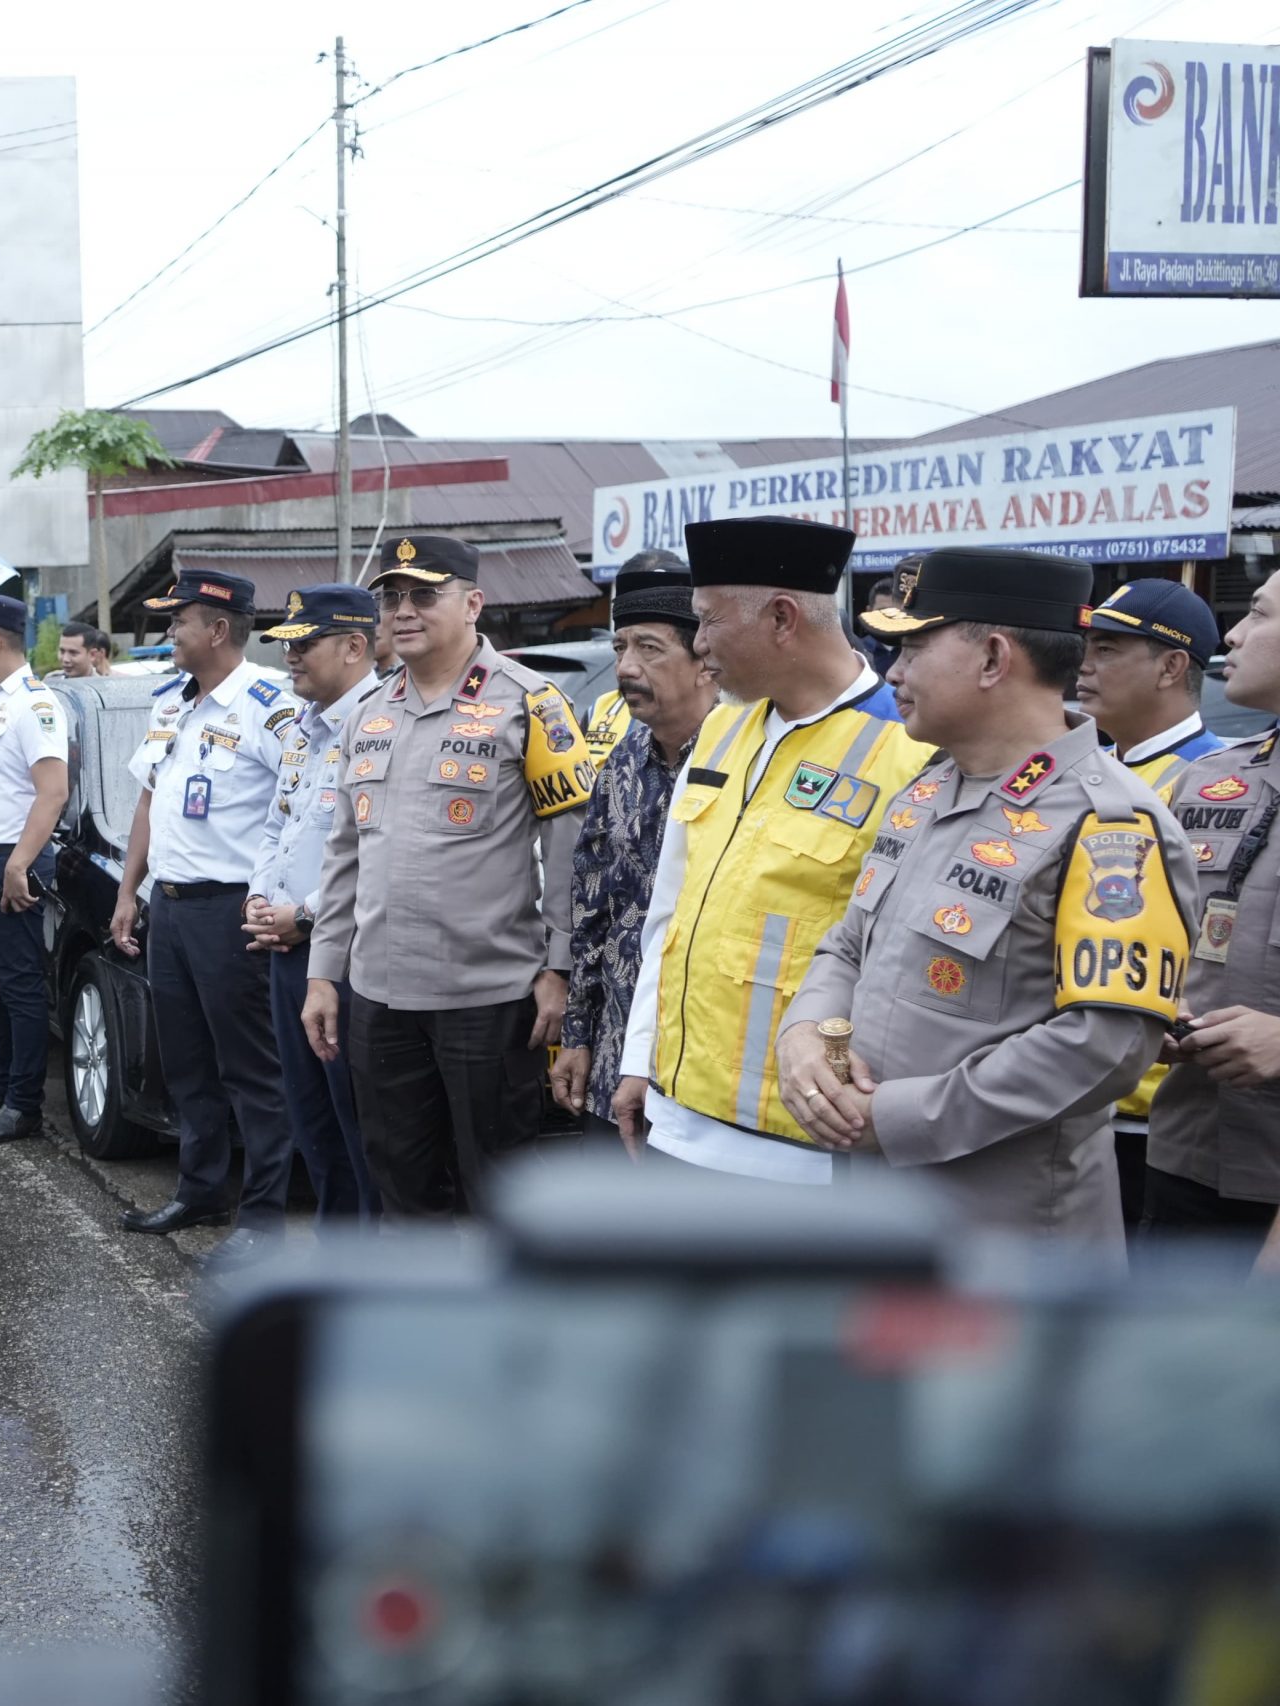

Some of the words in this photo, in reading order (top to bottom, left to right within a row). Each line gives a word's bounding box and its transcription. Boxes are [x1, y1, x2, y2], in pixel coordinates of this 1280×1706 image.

[1120, 258, 1132, 281] Jl.
[1134, 258, 1158, 288] Raya
[1160, 258, 1194, 288] Padang
[1196, 259, 1246, 288] Bukittinggi
[642, 483, 716, 551] BANK
[728, 450, 985, 509] PERKREDITAN
[1001, 423, 1213, 483] RAKYAT
[999, 479, 1211, 531] ANDALAS
[1070, 544, 1094, 558] Fax
[1106, 541, 1150, 559] (0751)
[1153, 538, 1207, 555] 675432
[1151, 623, 1192, 646] DBMCKTR
[354, 739, 392, 754] GUPUH
[440, 739, 497, 758] POLRI
[1182, 806, 1248, 830] GAYUH
[1088, 833, 1147, 849] POLDA
[946, 863, 1008, 902] POLRI
[1074, 938, 1148, 992] OPS
